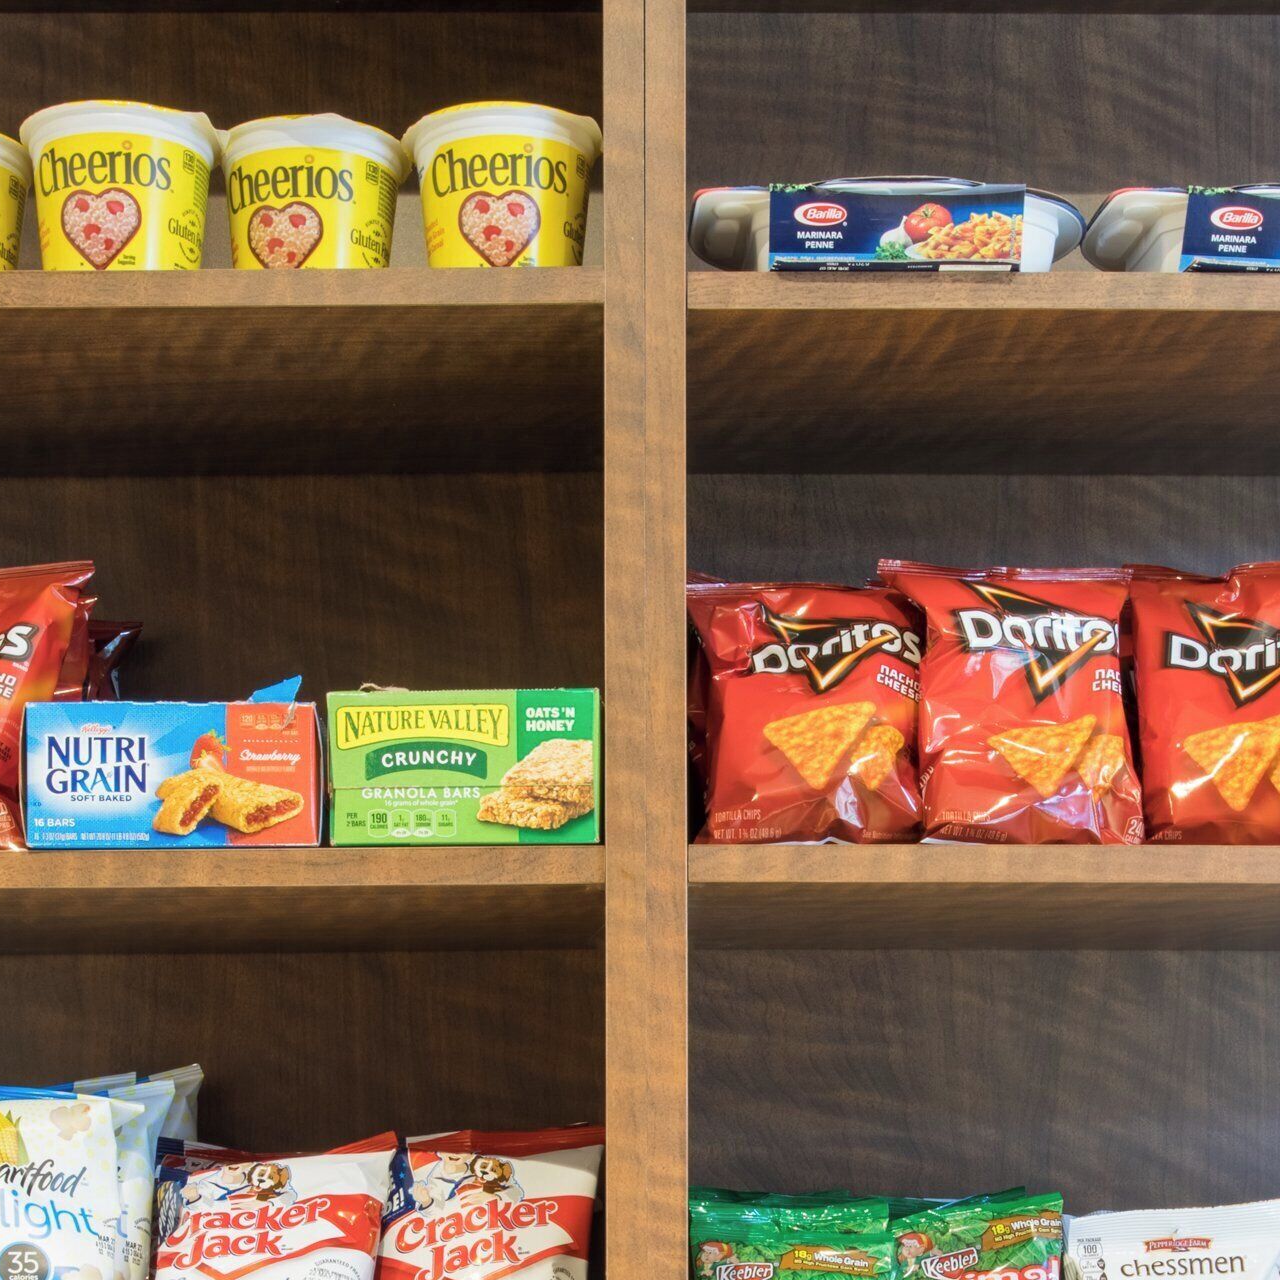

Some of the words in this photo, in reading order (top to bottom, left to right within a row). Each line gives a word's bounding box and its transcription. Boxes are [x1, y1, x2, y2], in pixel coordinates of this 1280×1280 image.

[40, 140, 171, 197] Cheerios
[432, 143, 567, 197] Cheerios
[229, 154, 354, 215] Cheerios
[807, 208, 842, 221] Barilla
[797, 231, 843, 240] MARINARA
[805, 241, 834, 249] PENNE
[1211, 234, 1257, 245] MARINARA
[1218, 244, 1247, 253] PENNE
[752, 623, 920, 674] Doritos
[345, 709, 426, 742] NATURE
[429, 708, 503, 740] VALLEY
[525, 707, 560, 718] OATS
[526, 720, 575, 731] HONEY
[47, 736, 146, 769] NUTRI
[239, 749, 301, 763] Strawberry
[381, 750, 477, 767] CRUNCHY
[46, 763, 147, 793] GRAIN
[361, 788, 441, 799] GRANOLA
[444, 787, 480, 798] BARS
[34, 819, 44, 827] 16
[47, 819, 75, 827] BARS
[166, 1197, 330, 1247] Cracker
[395, 1198, 559, 1254] Cracker
[7, 1250, 40, 1275] 35
[173, 1229, 286, 1271] Jack
[1120, 1253, 1245, 1278] chessmen
